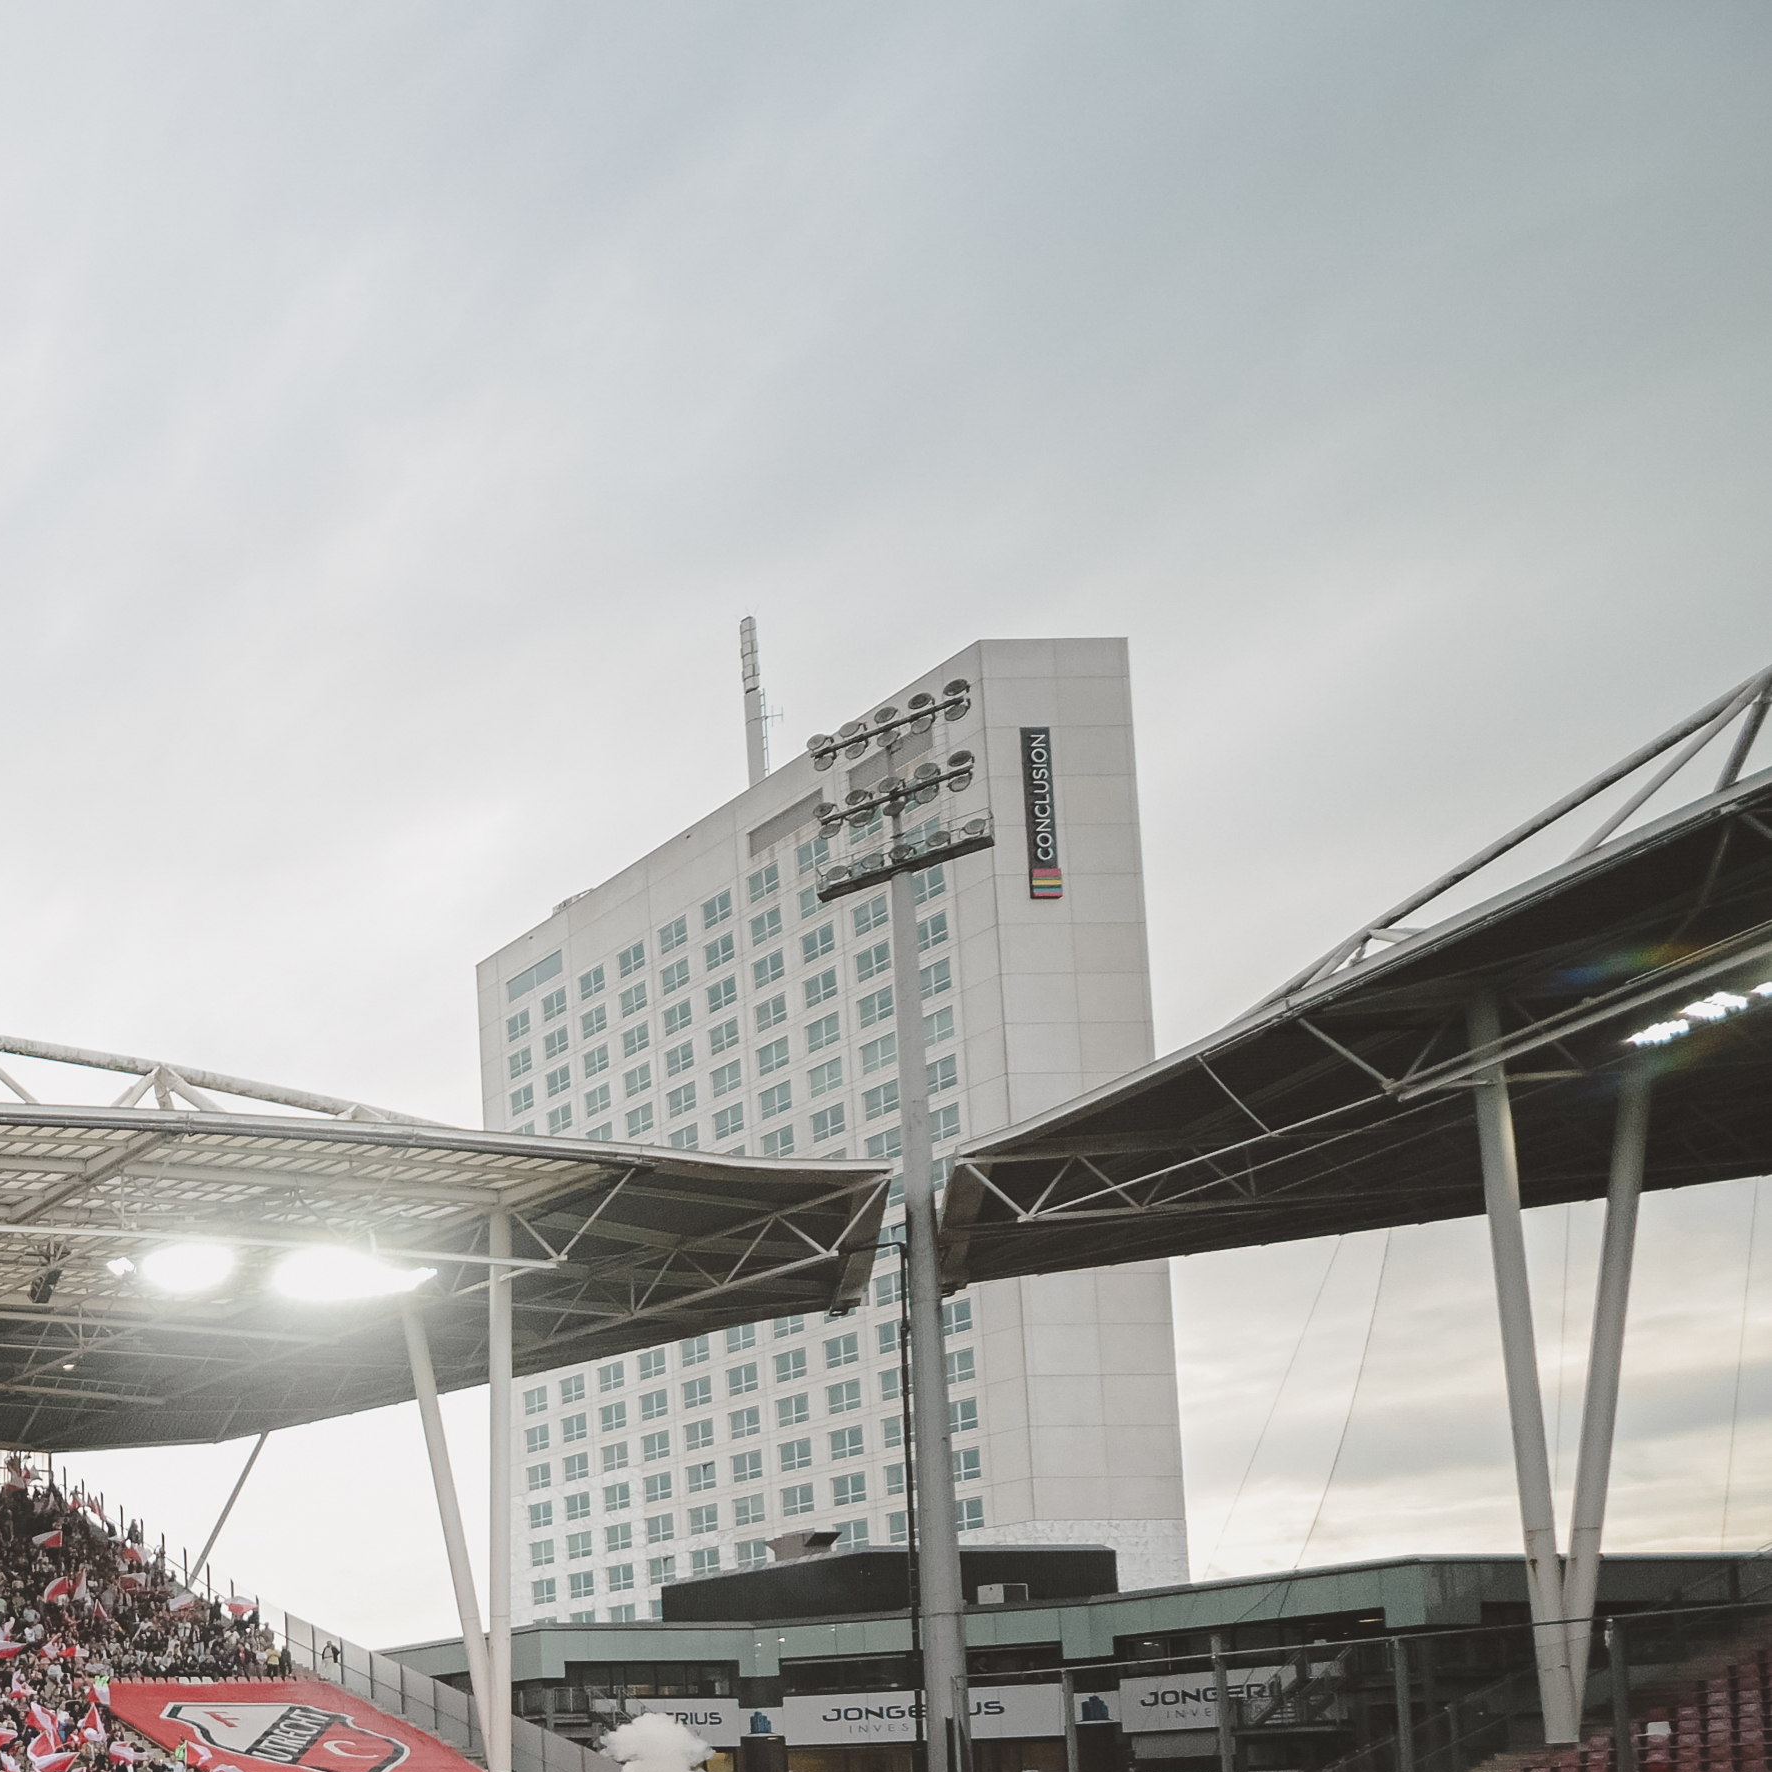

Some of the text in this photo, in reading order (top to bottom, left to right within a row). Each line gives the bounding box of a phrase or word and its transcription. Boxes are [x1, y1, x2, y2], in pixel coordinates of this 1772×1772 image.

[1030, 733, 1054, 861] CONCLUSION
[848, 1722, 910, 1734] INVES
[1166, 1707, 1212, 1719] INVE
[251, 1708, 330, 1763] UTRECHT
